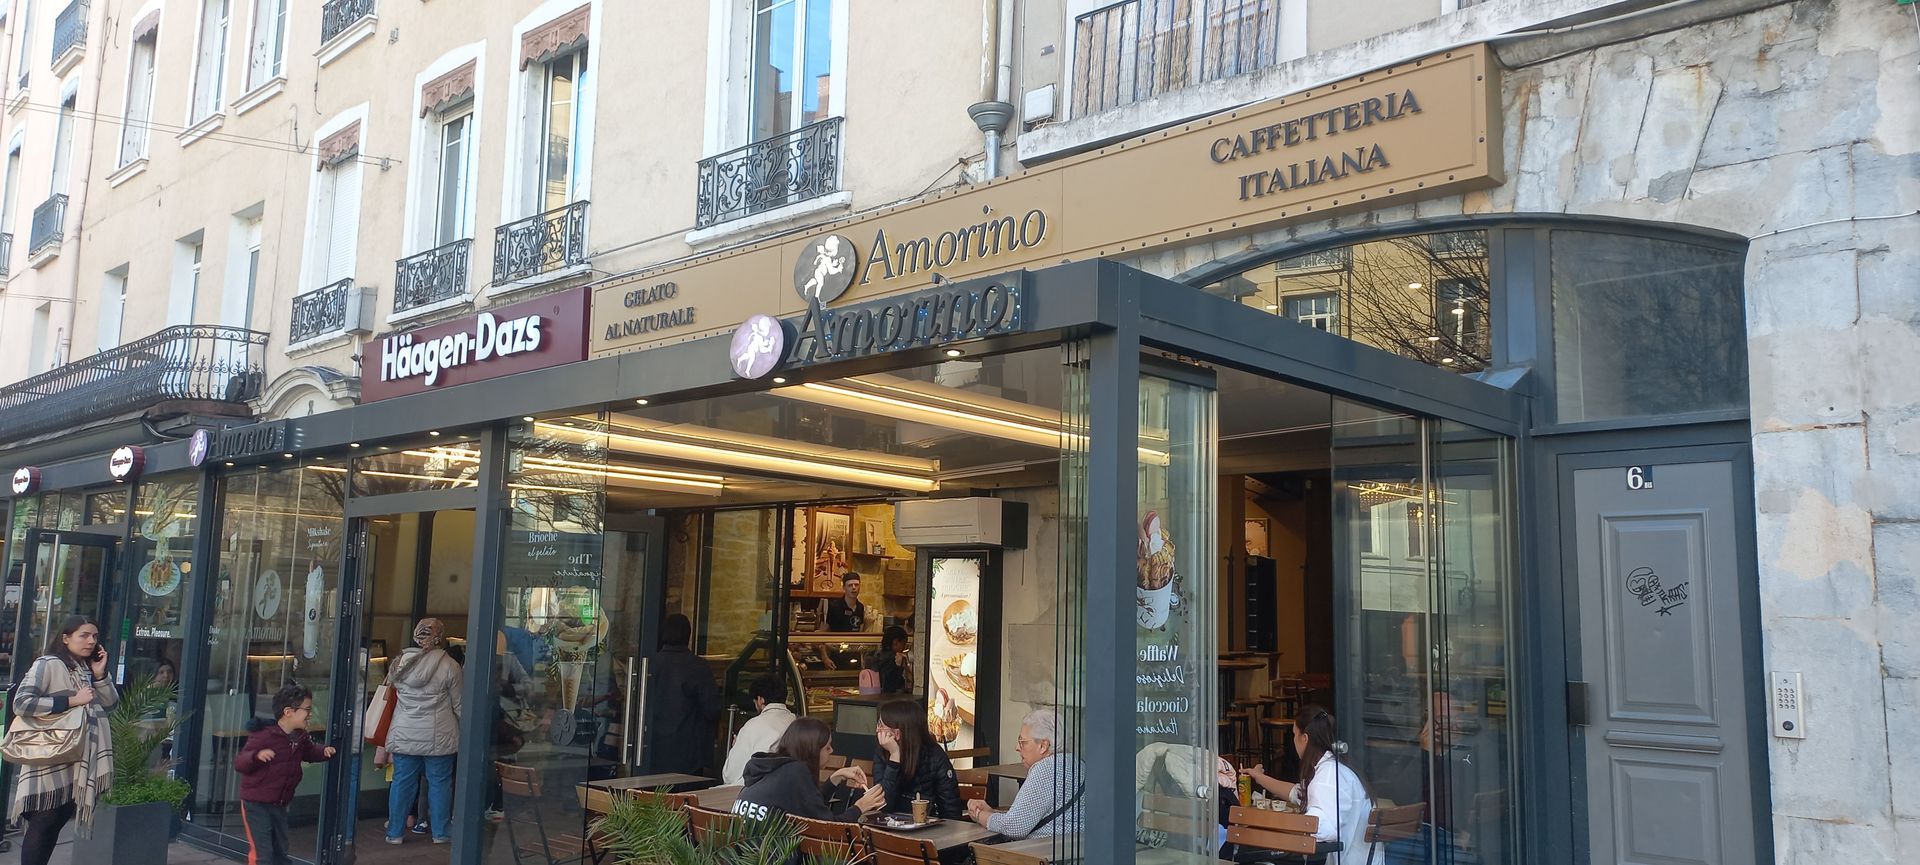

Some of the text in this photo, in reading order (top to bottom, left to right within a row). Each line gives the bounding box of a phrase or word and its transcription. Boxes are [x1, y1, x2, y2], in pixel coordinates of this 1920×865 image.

[1210, 88, 1423, 163] CAFFETTERIA
[1238, 143, 1391, 201] ITALIANA
[860, 204, 1048, 286] Amorino
[624, 281, 677, 308] GELATO
[604, 306, 695, 341] AL NATURALE
[784, 281, 1010, 364] Amorino
[380, 312, 541, 386] Häagen-Dazs
[1627, 466, 1643, 490] 6
[528, 531, 558, 543] Brioche
[535, 545, 557, 560] gelato
